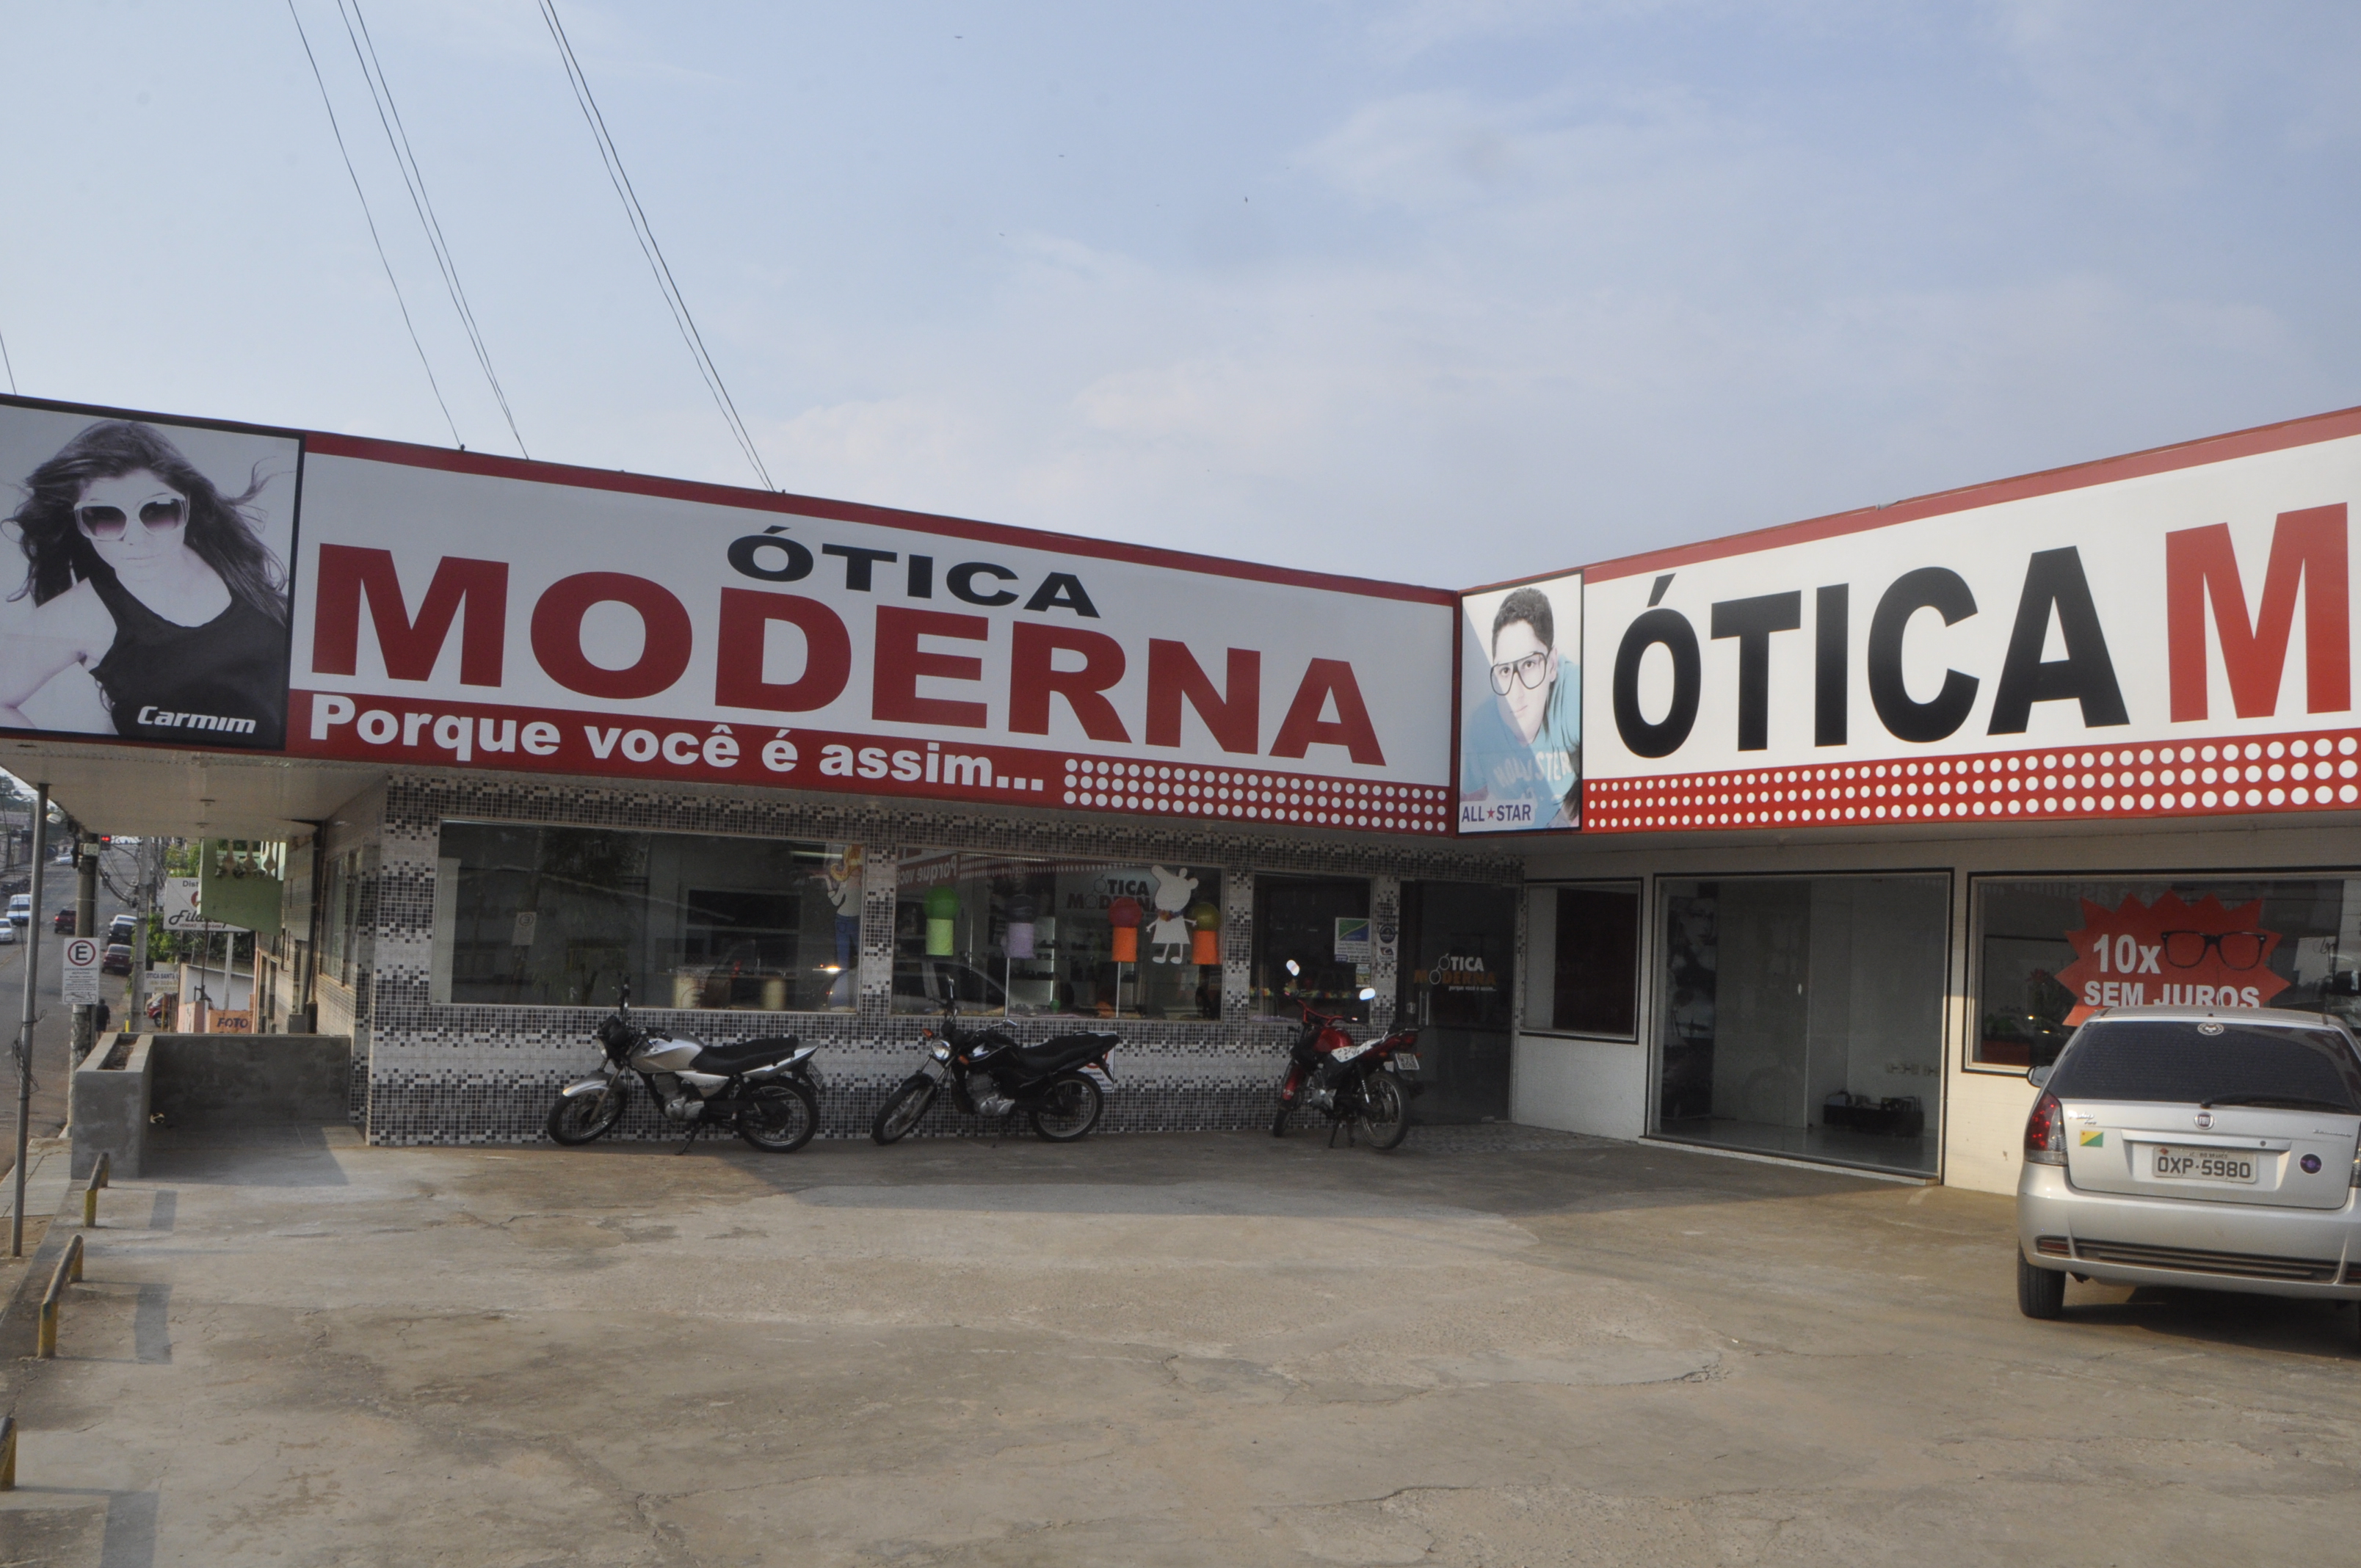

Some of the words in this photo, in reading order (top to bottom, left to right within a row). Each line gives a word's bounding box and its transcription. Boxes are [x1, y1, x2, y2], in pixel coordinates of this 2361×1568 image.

[727, 525, 1100, 618] ÓTICA
[1613, 573, 2130, 758] ÓTICA
[2166, 502, 2351, 722] M
[312, 543, 1387, 766] MODERNA
[137, 705, 256, 733] Carmim
[310, 694, 561, 761] Porque
[584, 725, 740, 768] você
[761, 730, 798, 772] é
[819, 742, 1043, 791] assim...
[1461, 805, 1484, 822] ALL
[1496, 804, 1531, 821] STAR
[76, 945, 87, 960] E
[2093, 934, 2161, 974] 10x
[2084, 981, 2144, 1006] SEM
[2153, 984, 2260, 1009] JUROS
[217, 1017, 248, 1028] FOTO
